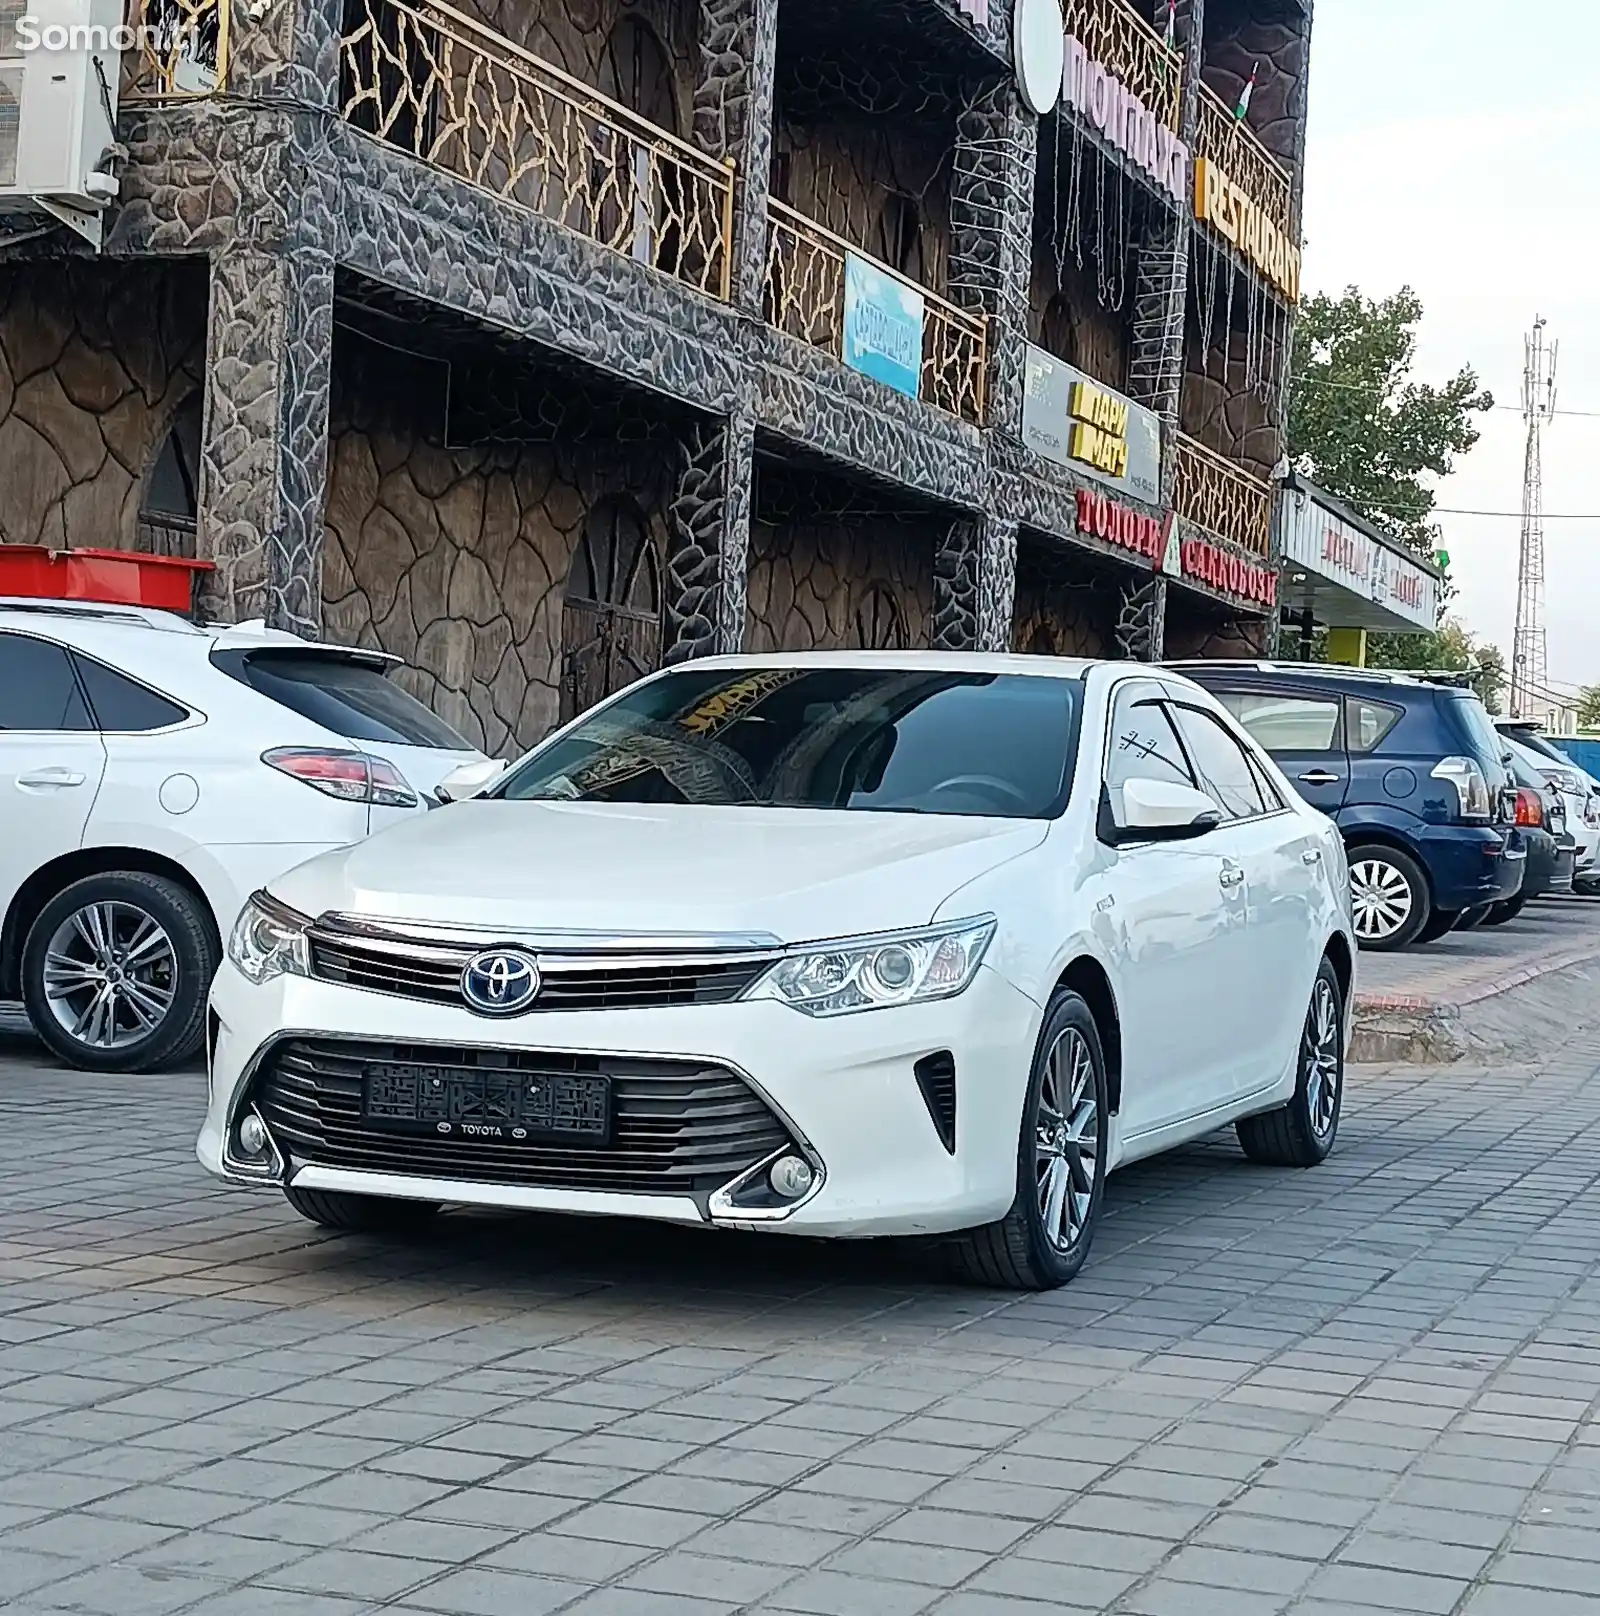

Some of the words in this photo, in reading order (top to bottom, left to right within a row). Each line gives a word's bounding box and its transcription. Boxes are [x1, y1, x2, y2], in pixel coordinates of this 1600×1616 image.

[1200, 156, 1301, 304] RESTAURANT
[1070, 381, 1129, 438] ПАРИ
[1070, 422, 1129, 478] МАТЧ
[460, 1123, 502, 1137] TOYOTA
